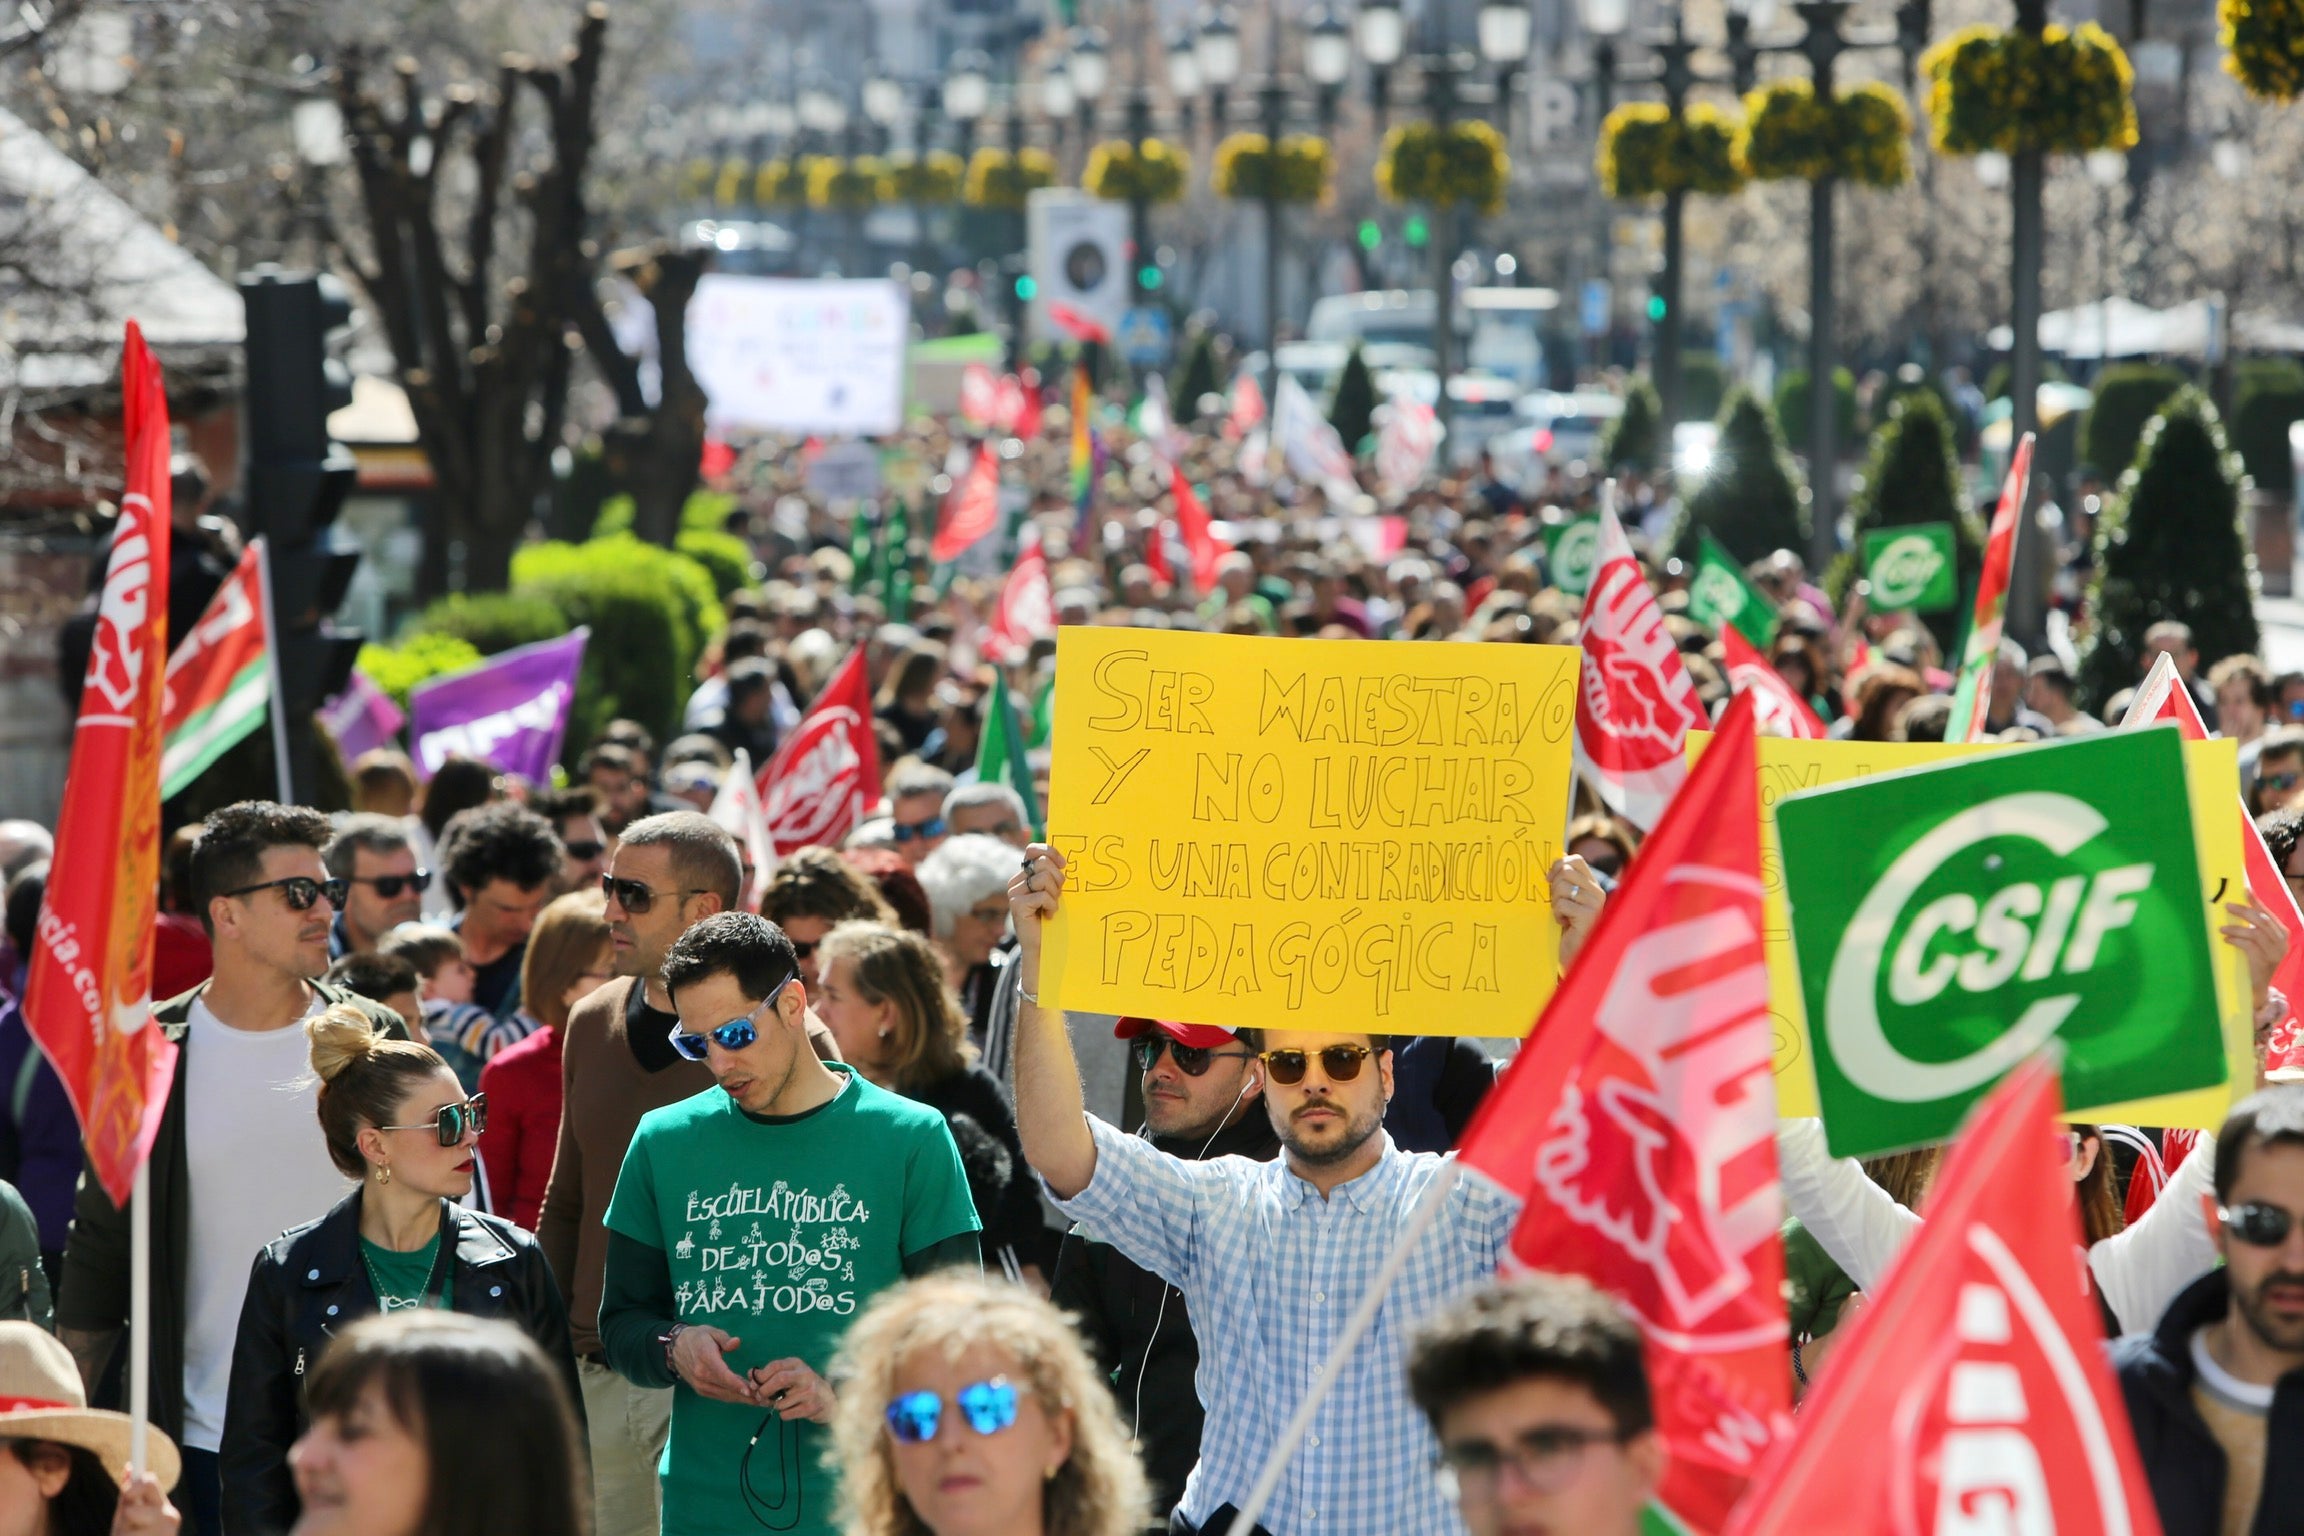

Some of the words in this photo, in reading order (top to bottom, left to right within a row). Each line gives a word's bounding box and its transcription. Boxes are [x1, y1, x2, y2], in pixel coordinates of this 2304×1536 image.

[1088, 649, 1214, 735] SER
[1259, 657, 1576, 757] MAESTRA/O
[1088, 746, 1152, 805] Y
[1193, 752, 1284, 824] NO
[1309, 754, 1536, 829] LUCHAR
[1051, 834, 1131, 893] ES
[1150, 839, 1251, 899] UNA
[1263, 826, 1553, 904] CONTRADICCIÓN
[1100, 906, 1501, 1017] PEDAGÓGICA
[1888, 861, 2156, 1007] CSIF
[686, 1188, 780, 1222] ESCUELA
[783, 1187, 870, 1224] PÚBLICA:
[701, 1246, 741, 1273] DE
[747, 1241, 842, 1272] TOD@S
[679, 1286, 748, 1316] PARA
[753, 1285, 856, 1315] TOD@S
